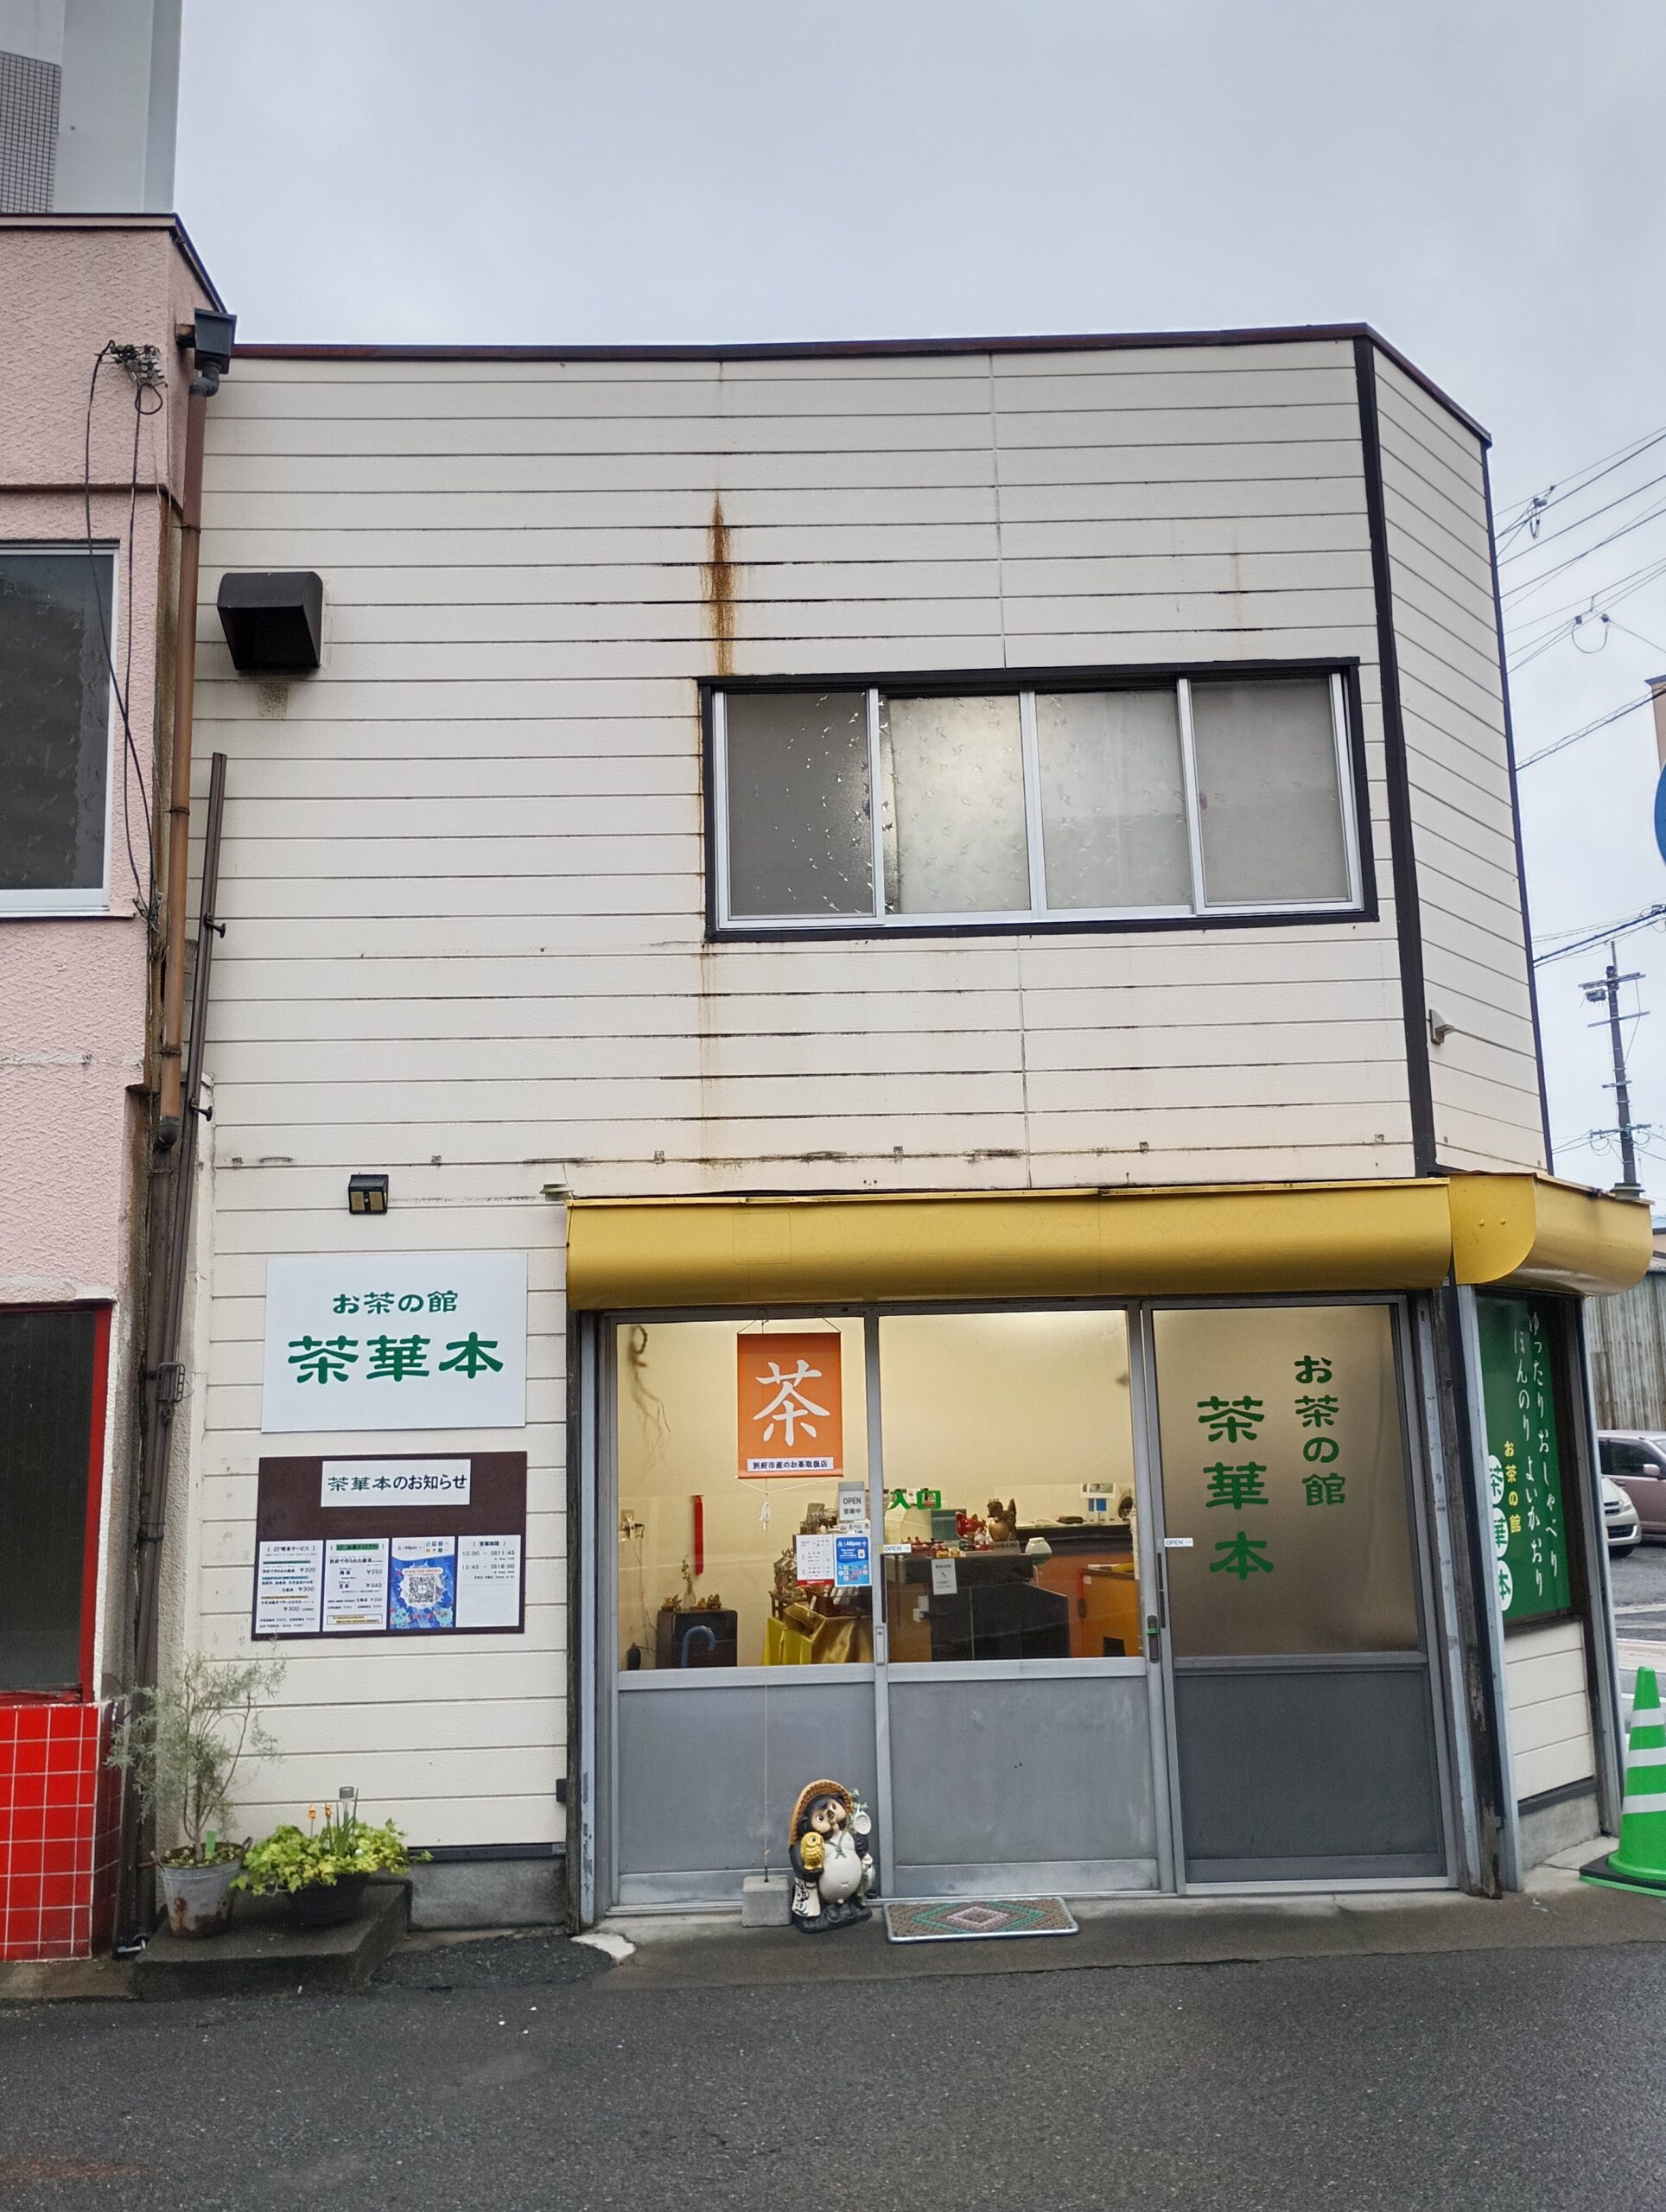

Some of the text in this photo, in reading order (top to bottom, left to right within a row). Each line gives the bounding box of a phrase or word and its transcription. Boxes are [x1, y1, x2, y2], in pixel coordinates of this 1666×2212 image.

[333, 1290, 458, 1314] お茶の館
[288, 1332, 503, 1384] 茶華本
[753, 1359, 830, 1446] 茶
[1294, 1355, 1345, 1506] お茶の館
[327, 1474, 467, 1491] 茶華本のお知らせ
[753, 1459, 828, 1470] 別府市産のお茶取扱店
[1197, 1395, 1274, 1580] 茶華本
[1504, 1440, 1522, 1534] お茶の館
